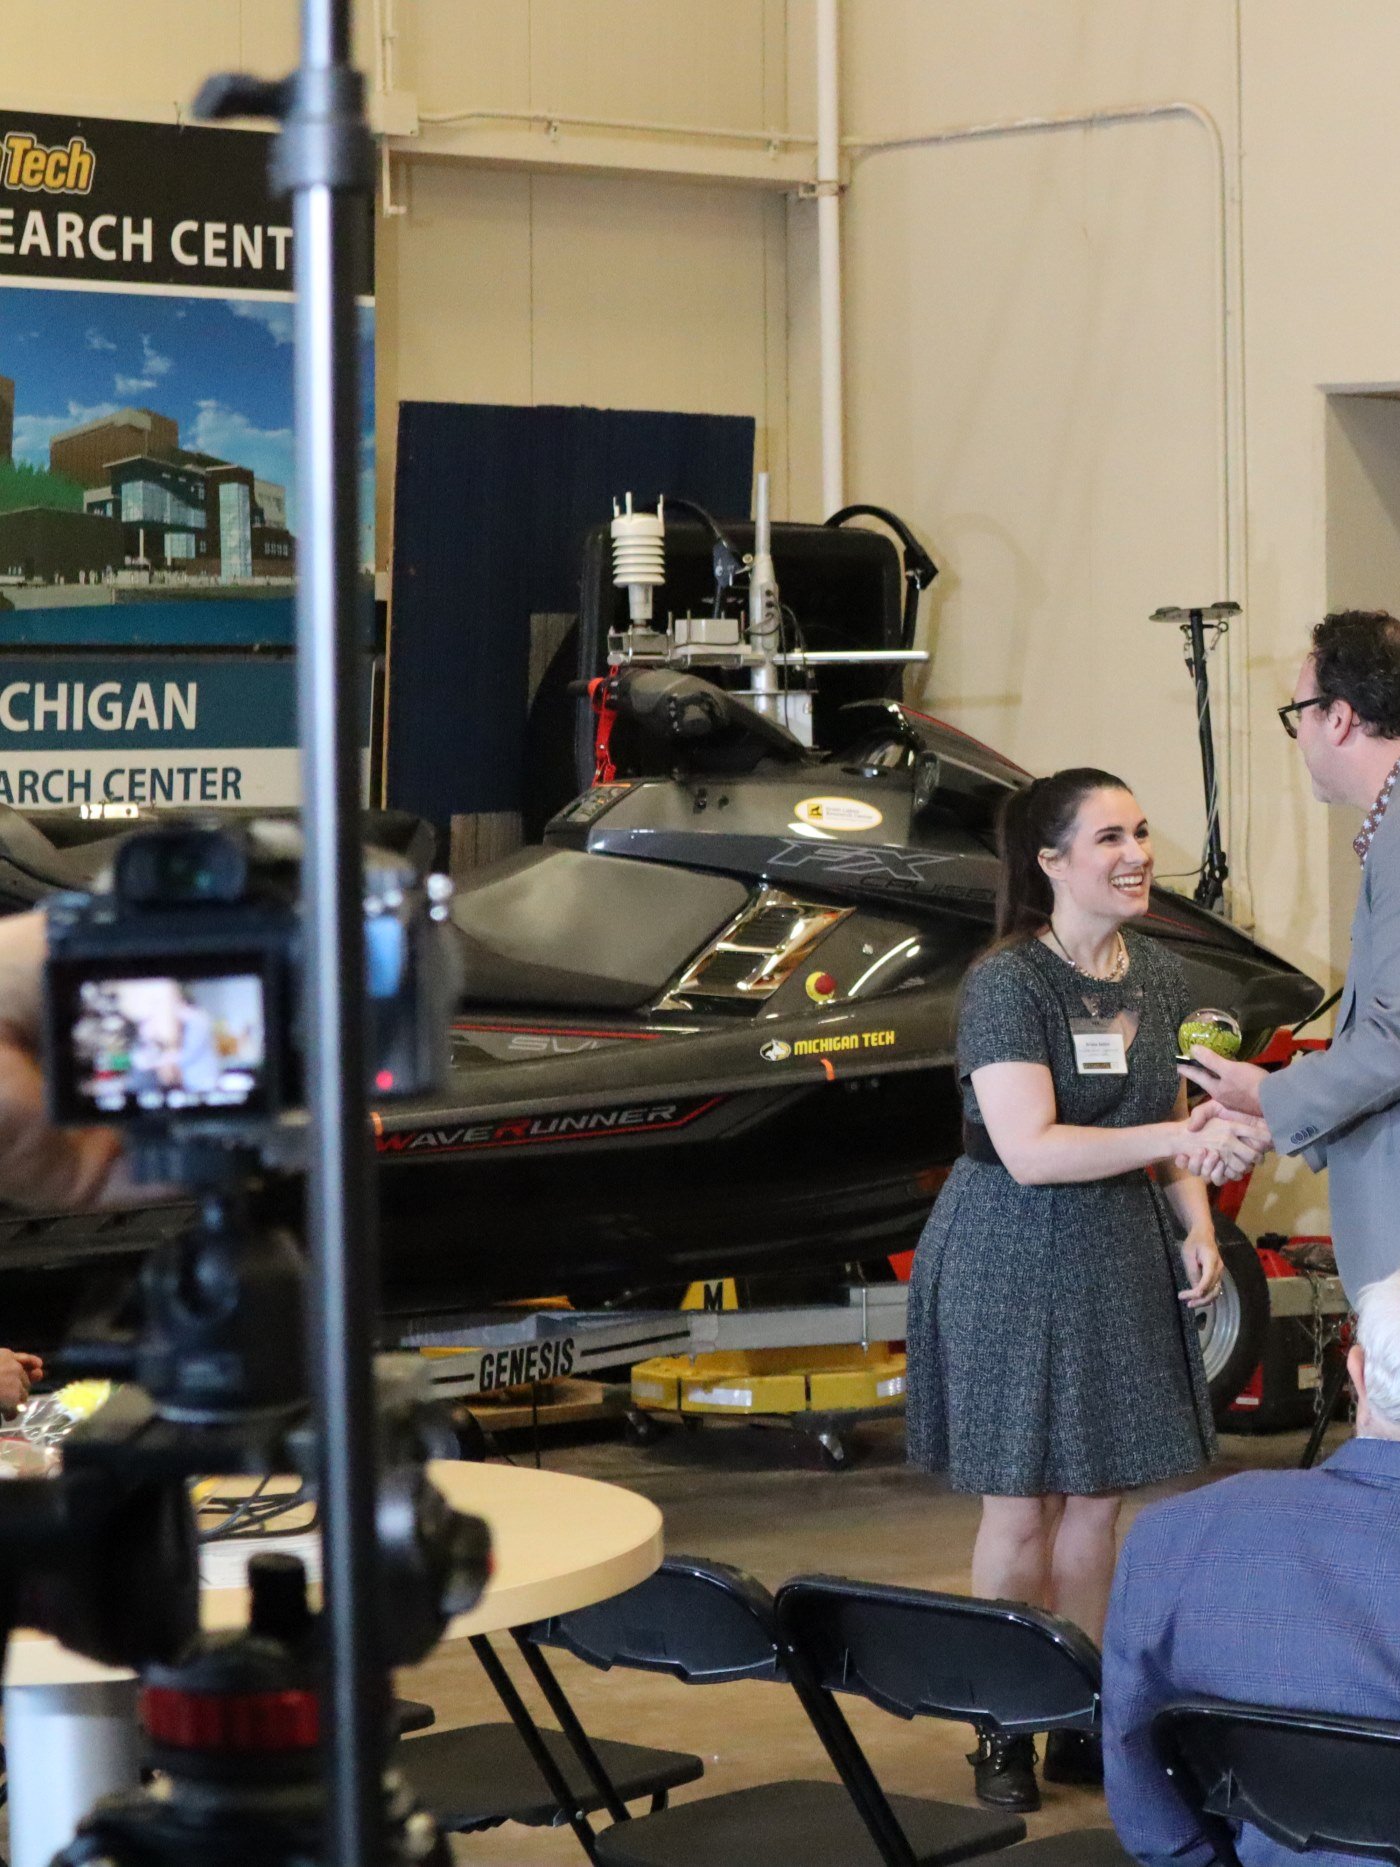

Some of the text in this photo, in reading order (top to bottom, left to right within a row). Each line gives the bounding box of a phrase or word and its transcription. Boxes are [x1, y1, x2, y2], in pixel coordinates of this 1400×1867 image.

[6, 134, 94, 191] Tech
[0, 208, 153, 262] EARCH
[0, 682, 197, 731] CHIGAN
[103, 767, 242, 802] CENTER
[767, 838, 956, 882] FX
[794, 1030, 895, 1055] MICHIGAN TECH
[376, 1104, 677, 1151] WAVERUNNER
[703, 1281, 723, 1311] M
[479, 1337, 576, 1393] GENESIS
